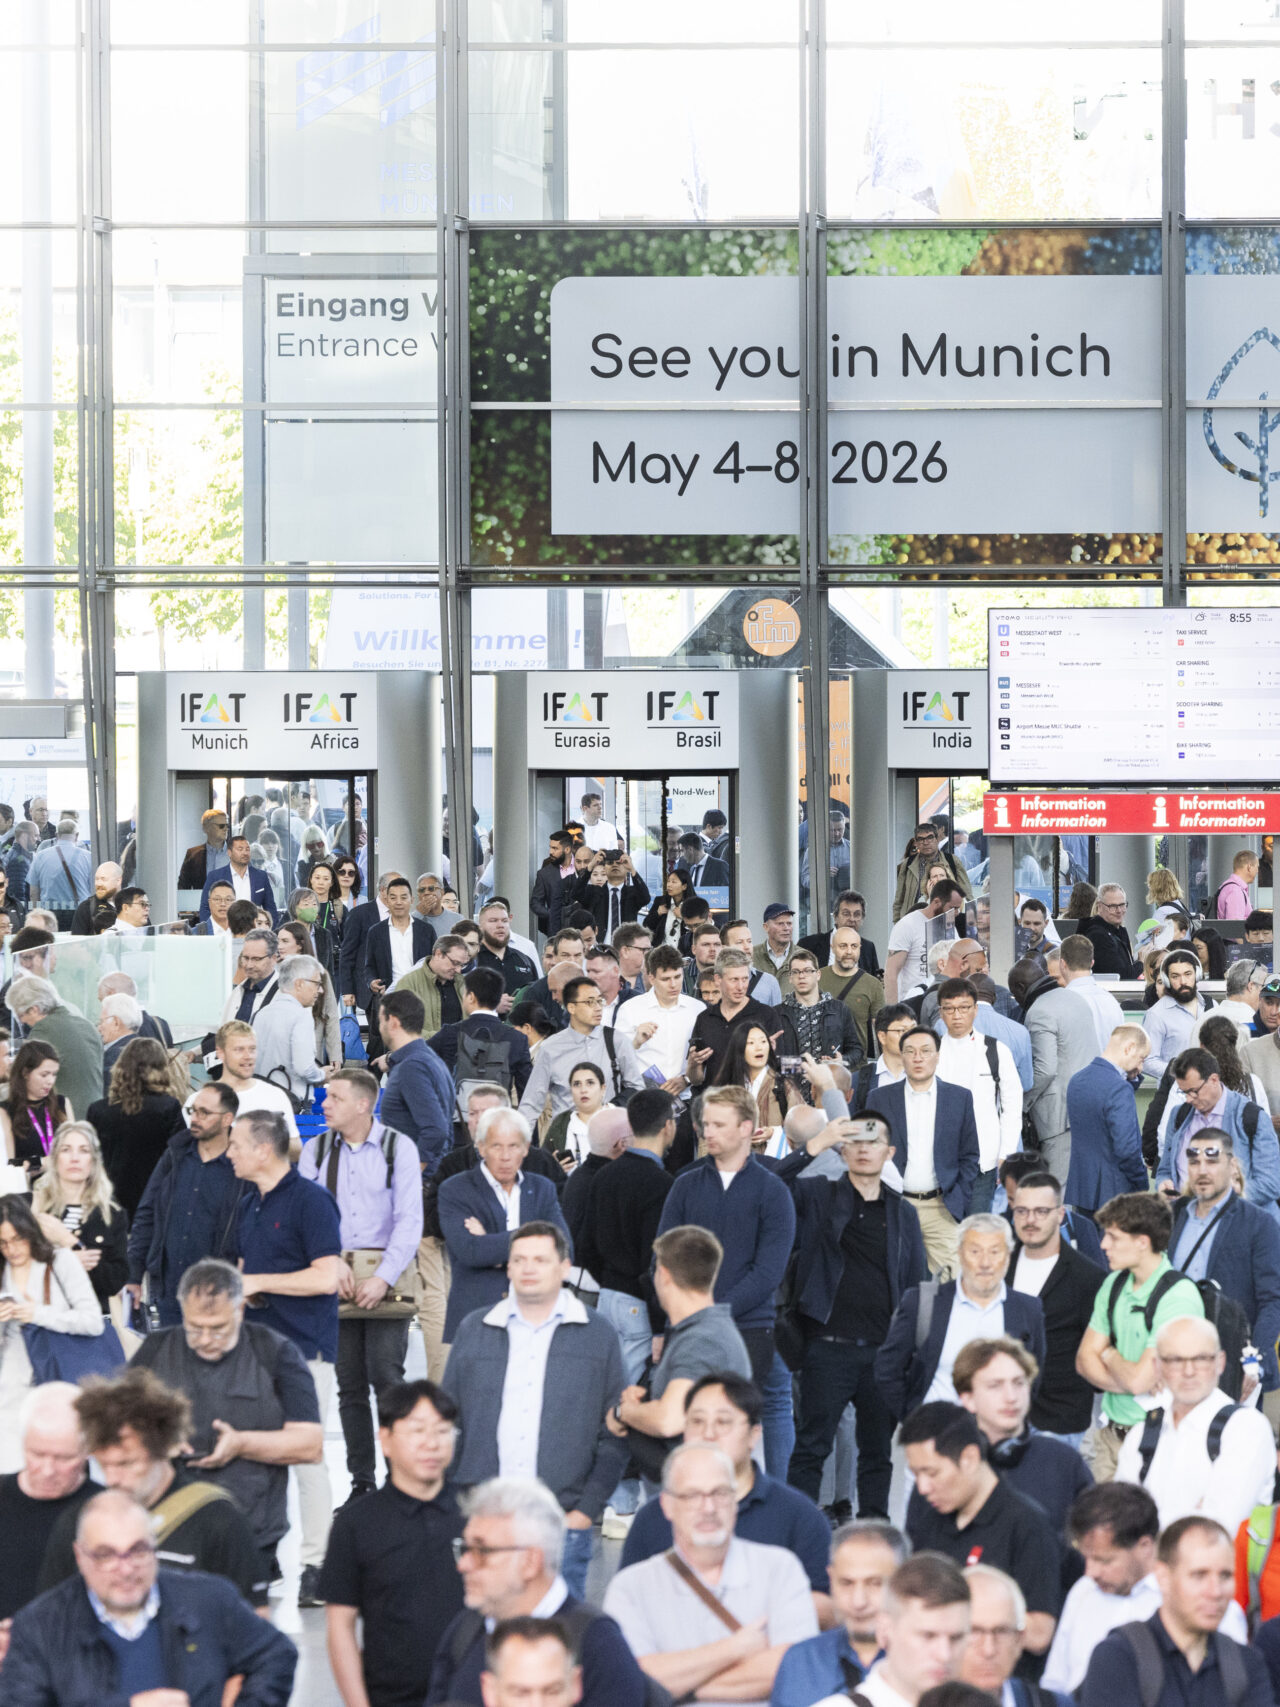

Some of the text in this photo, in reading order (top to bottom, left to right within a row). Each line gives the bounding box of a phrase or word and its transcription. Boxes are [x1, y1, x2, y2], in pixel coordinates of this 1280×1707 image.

[379, 190, 514, 213] MÜNEN
[276, 292, 409, 322] Eingang
[277, 332, 418, 357] Entrance
[589, 332, 1110, 391] See you in Munich
[592, 441, 700, 497] May
[831, 440, 948, 484] 2026
[1229, 613, 1252, 622] 8:55
[353, 629, 582, 652] Willkmme!
[181, 693, 246, 723] IFAT
[283, 693, 357, 723] IFAT
[543, 692, 609, 722] IFAT
[646, 690, 720, 721] IFAT
[903, 691, 970, 721] IFAT
[192, 734, 248, 750] Munich
[310, 733, 359, 749] Africa
[555, 732, 611, 747] Eurasia
[676, 731, 721, 748] Brasil
[933, 732, 972, 748] India
[672, 787, 716, 796] Nord-West
[1021, 796, 1106, 811] Information
[1179, 796, 1265, 810] Information
[1021, 814, 1107, 828] Information
[1179, 814, 1266, 828] Information
